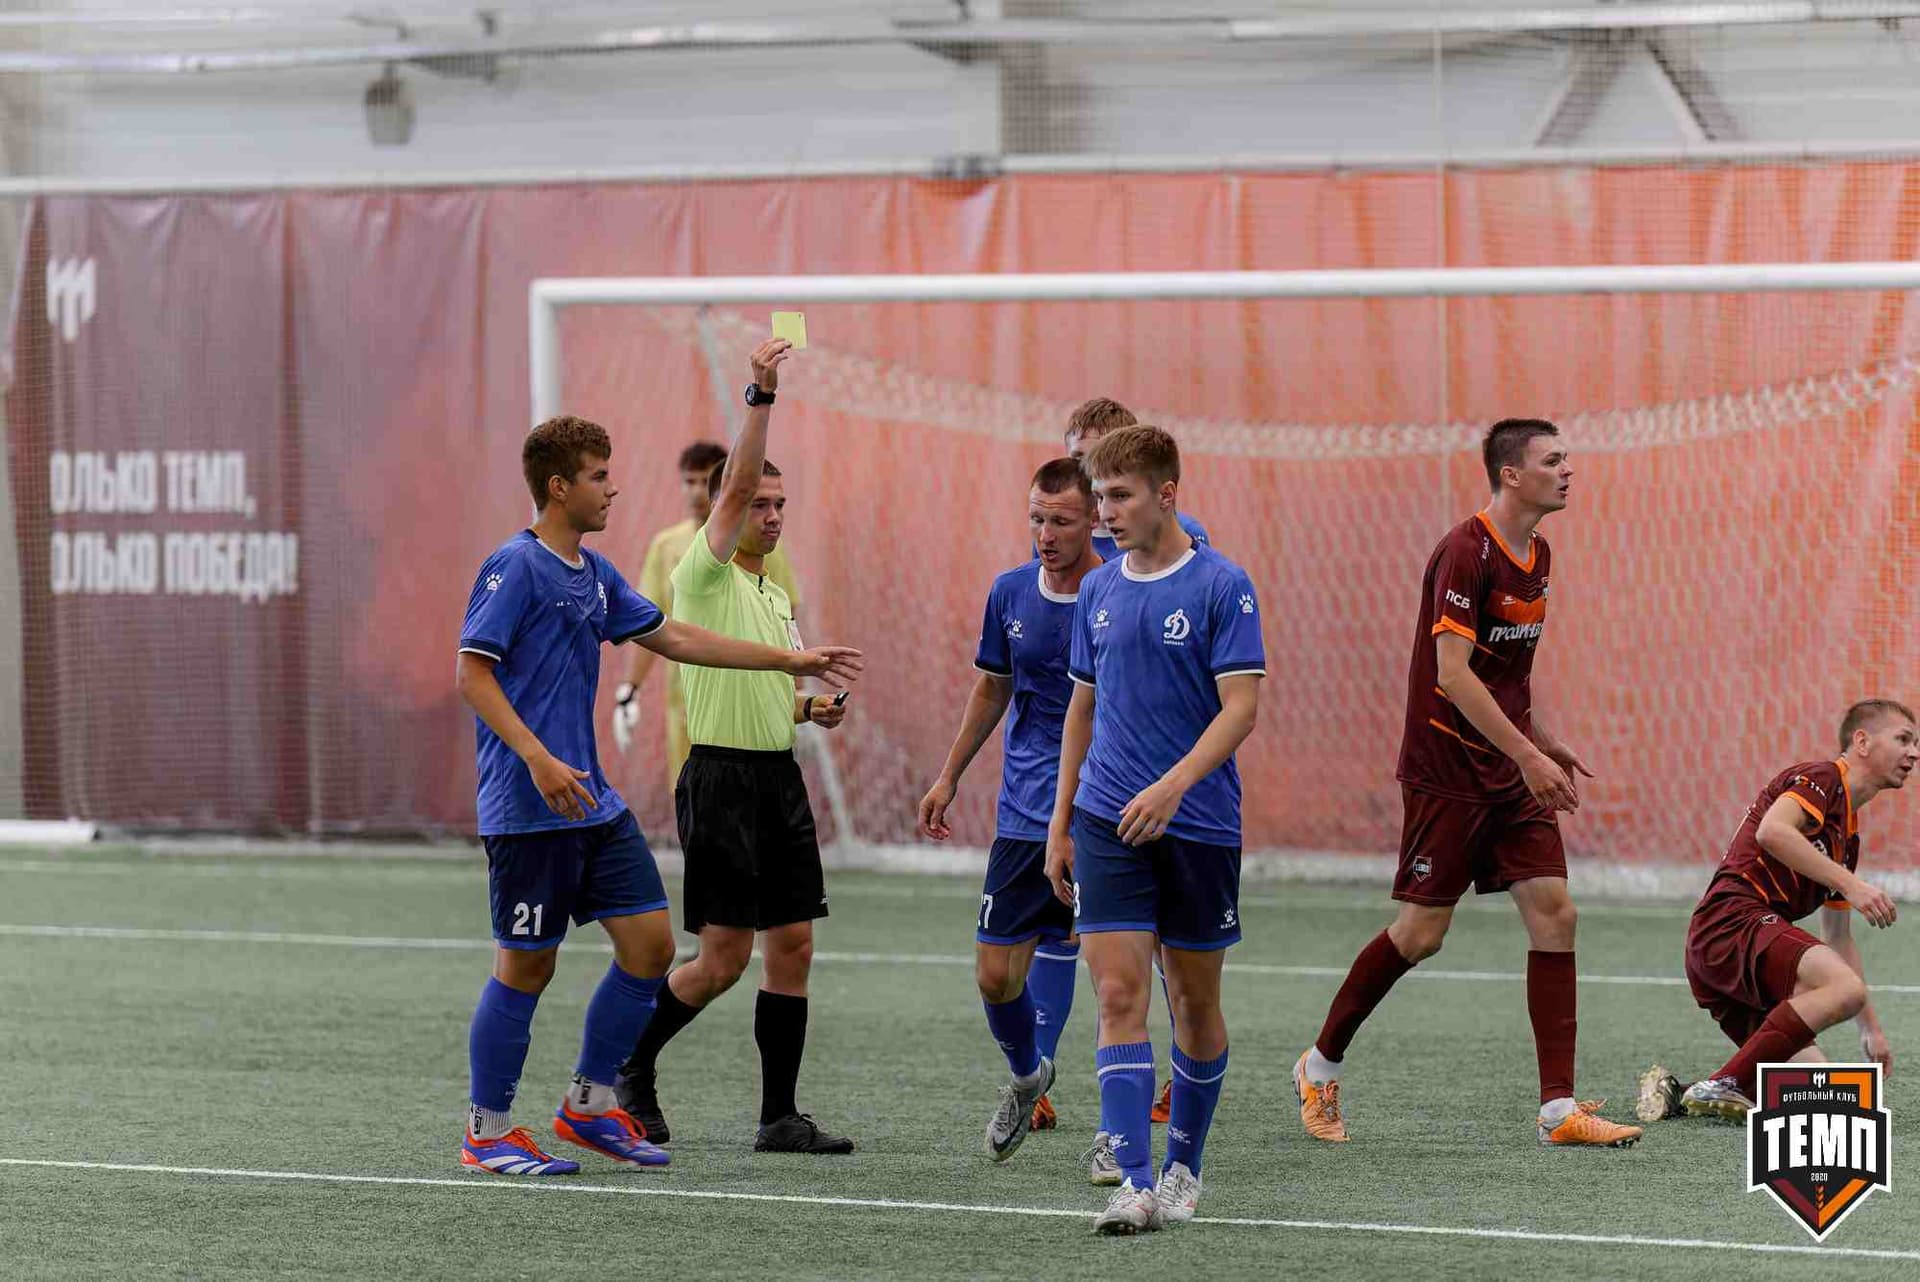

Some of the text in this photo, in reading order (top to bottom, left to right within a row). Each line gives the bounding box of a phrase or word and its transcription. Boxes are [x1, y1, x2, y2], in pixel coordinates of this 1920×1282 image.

[50, 451, 157, 513] ОЛЬКО
[51, 531, 157, 594] ОЛЬКО
[1446, 589, 1470, 609] ПСБ
[512, 902, 542, 936] 21
